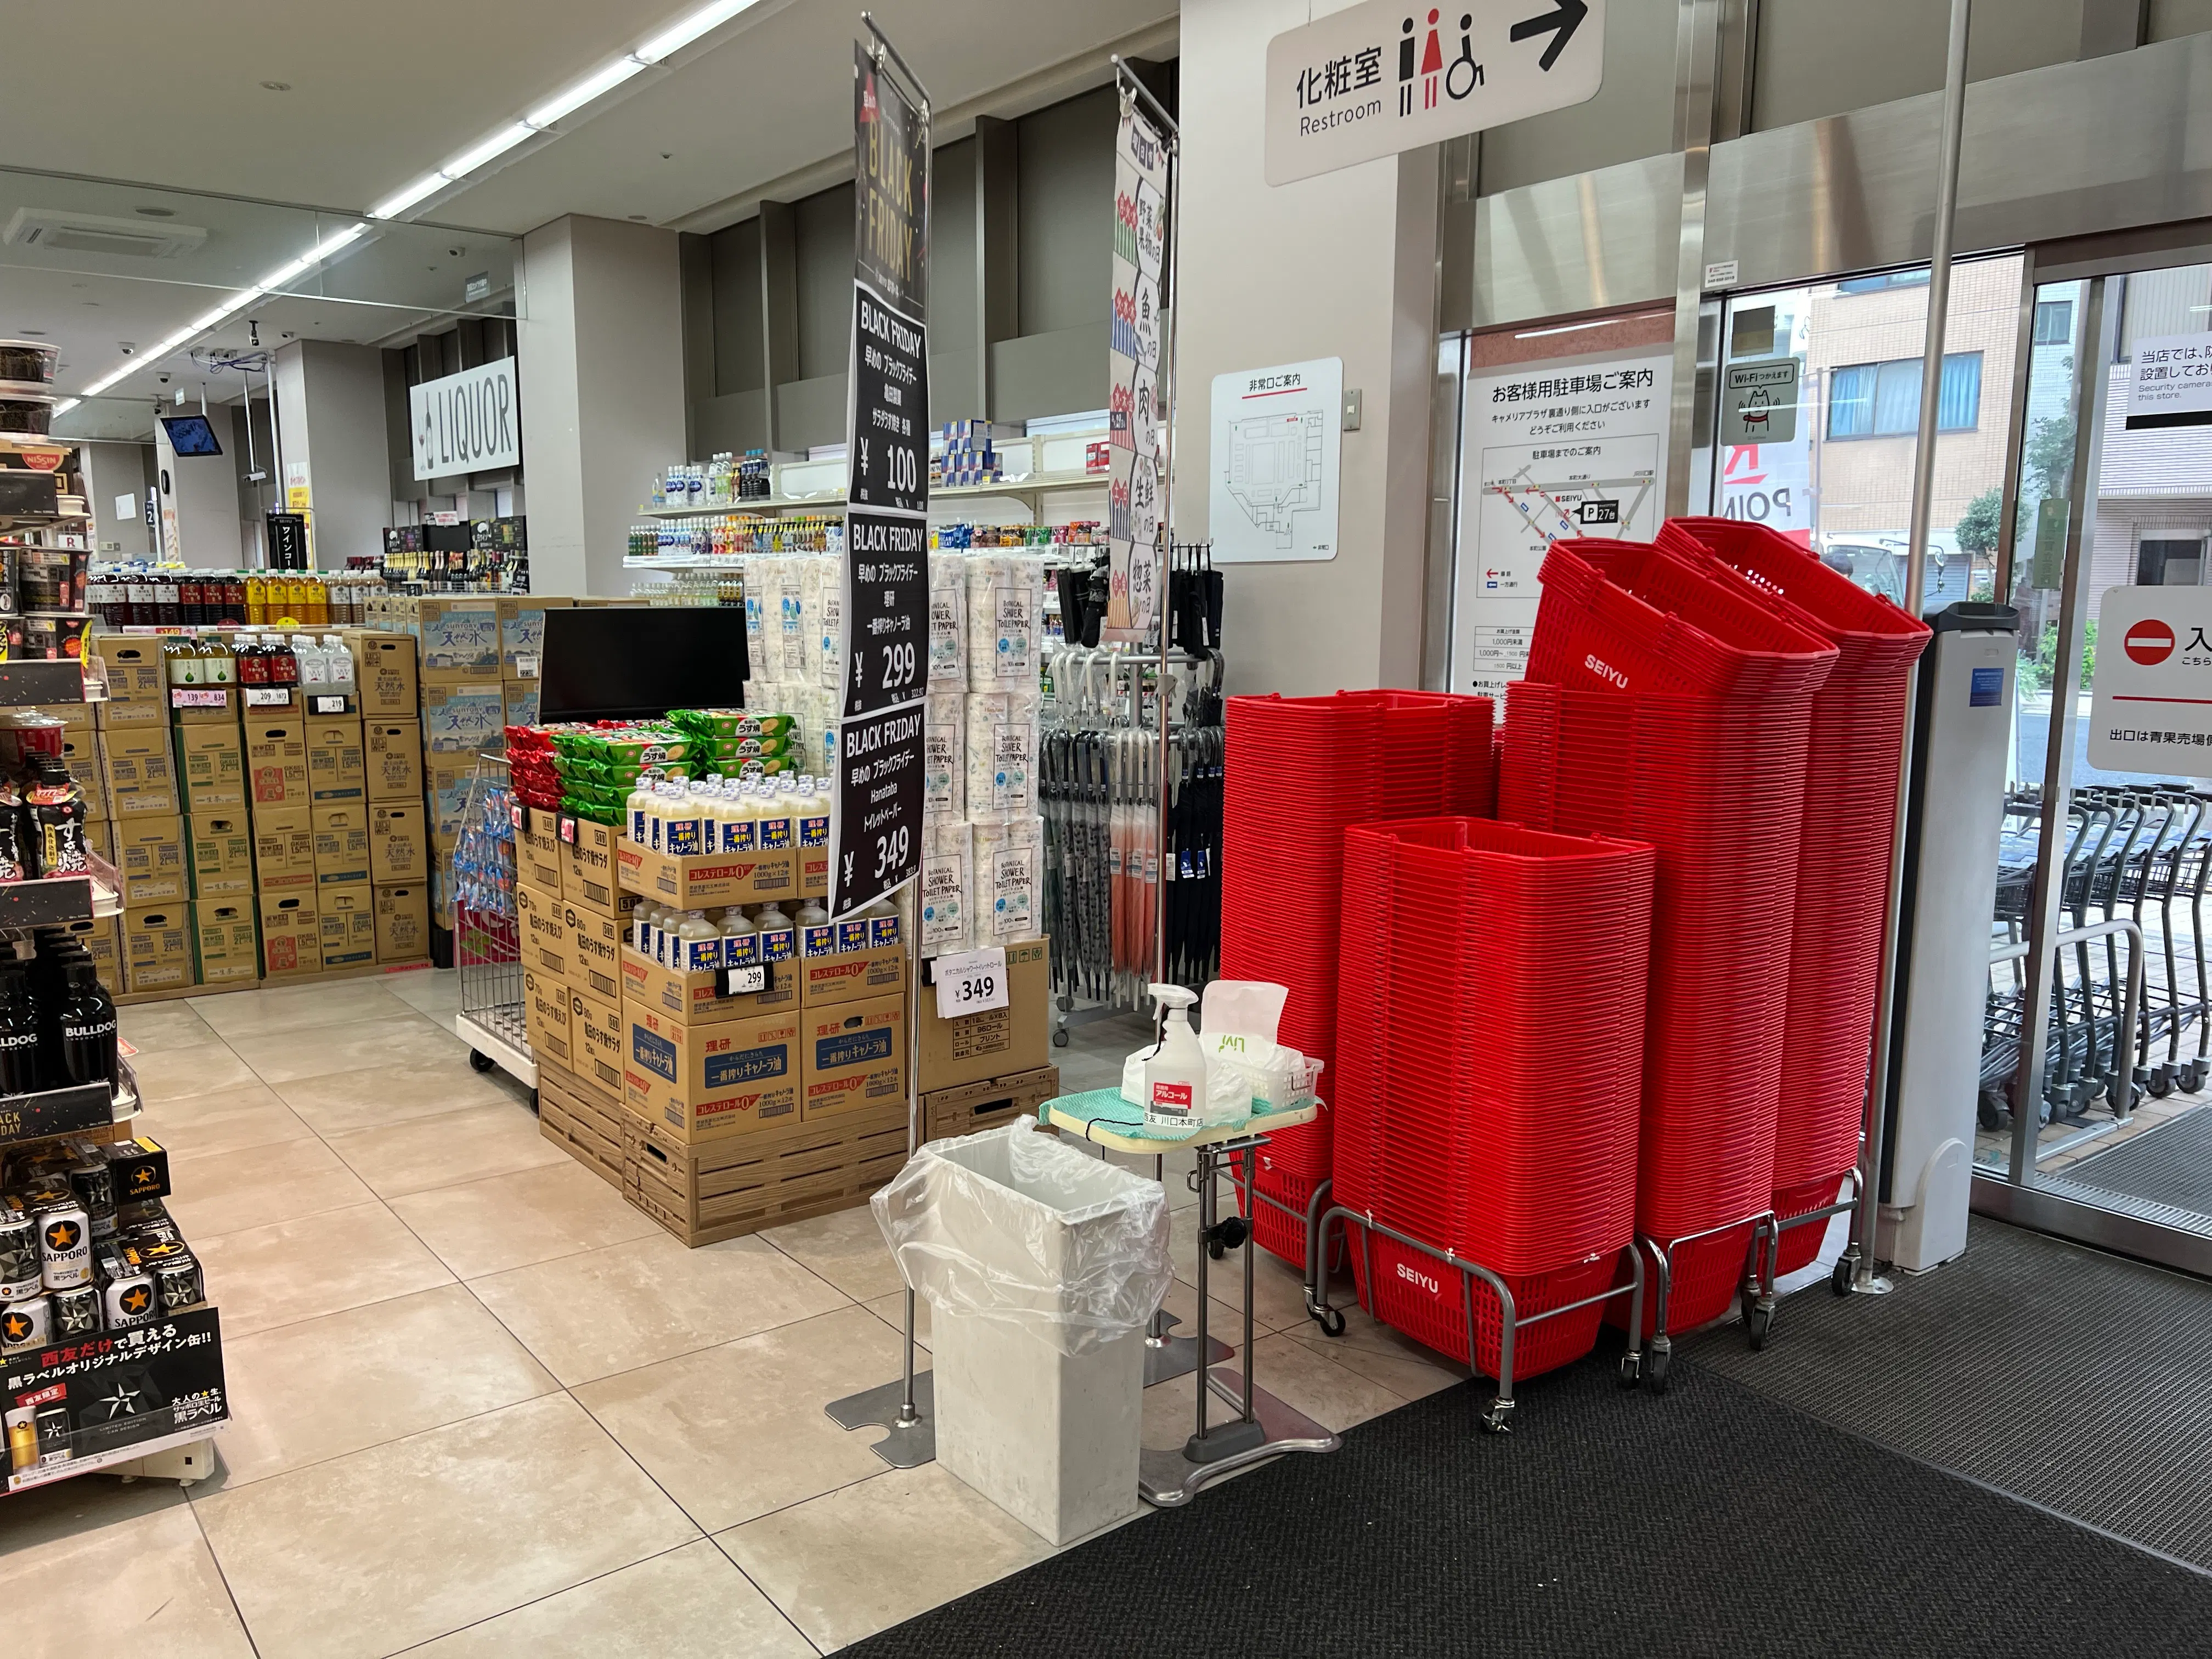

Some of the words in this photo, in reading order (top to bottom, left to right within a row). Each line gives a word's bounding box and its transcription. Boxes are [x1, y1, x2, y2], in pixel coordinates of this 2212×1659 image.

[1297, 46, 1381, 109] 化粧室
[1300, 98, 1381, 136] Restroom
[869, 115, 912, 217] BLACK
[1138, 198, 1153, 231] 野菜
[868, 187, 912, 281] FRIDAY
[1139, 287, 1152, 336] 魚
[861, 301, 890, 343] BLACK
[891, 319, 921, 359] FRIDAY
[865, 345, 882, 369] 早めの
[884, 353, 917, 385] ブラックフライデー
[2140, 364, 2212, 381] 設置してお
[1250, 373, 1301, 392] 非常口ご案内
[1492, 369, 1654, 403] お客様用駐車場ご案内
[2139, 381, 2175, 392] Security
[1138, 379, 1150, 427] 肉
[2138, 393, 2153, 401] this
[438, 374, 511, 464] LIQUOR
[1530, 421, 1605, 435] どうぞご利用ください
[27, 455, 57, 465] NISSIN
[1533, 446, 1601, 460] 駐車場までのご案内
[887, 444, 916, 493] 100
[147, 510, 154, 523] 2
[1587, 506, 1594, 518] P
[853, 524, 887, 551] BLACK
[889, 527, 923, 551] FRIDAY
[858, 563, 876, 583] 早めの
[879, 563, 918, 583] ブラックフライデー
[440, 630, 488, 647] 天然水
[882, 642, 915, 689] 299
[2182, 657, 2211, 666] こちら
[1584, 654, 1629, 689] SEIYU
[445, 715, 493, 730] 天然水
[847, 727, 881, 758] BLACK
[884, 714, 921, 748] FRIDAY
[851, 766, 870, 787] 早めの
[873, 748, 915, 780] ブラックフライデー
[871, 782, 897, 804] Hanataba
[54, 817, 87, 873] すき焼
[875, 825, 909, 878] 349
[928, 874, 954, 887] SHOWER
[1001, 867, 1024, 879] SHOWER
[1012, 877, 1031, 886] PAPER
[941, 884, 962, 894] PAPER
[747, 973, 762, 984] 299
[963, 976, 994, 1001] 349
[65, 1019, 116, 1037] BULLDOG
[817, 1023, 840, 1036] 理研
[980, 1033, 1000, 1042] プリント
[0, 1033, 37, 1047] LDOG
[706, 1038, 731, 1052] 理研
[821, 1039, 887, 1063] 一番搾りキャノーラ油
[711, 1055, 782, 1080] 一番搾りキャノーラ油
[1155, 1090, 1188, 1100] アルコール
[1161, 1116, 1204, 1127] 川口本町店
[129, 1183, 161, 1195] SAPPORO
[42, 1245, 87, 1263] SAPPORO
[1397, 1263, 1438, 1294] SEIYU
[41, 1324, 177, 1368] 西友だけで買える
[8, 1332, 211, 1390] 黒ラベルオリジナルデザイン缶!!
[172, 1392, 199, 1406] 大人の
[173, 1396, 221, 1412] サッポロ生ビール
[174, 1404, 222, 1424] 黒ラベル
